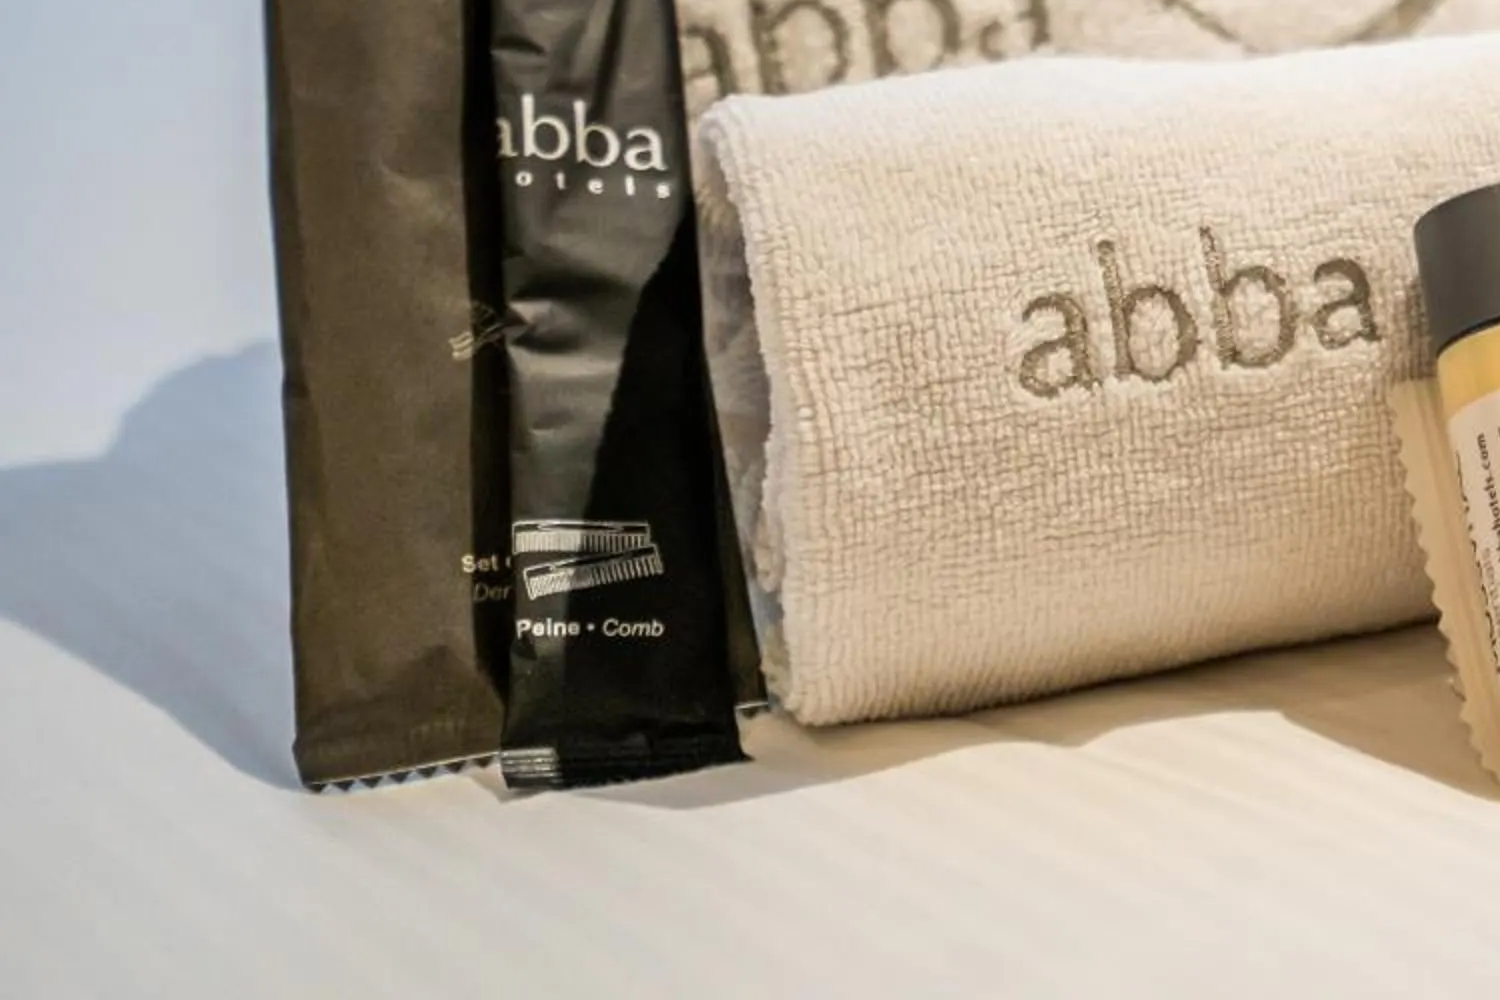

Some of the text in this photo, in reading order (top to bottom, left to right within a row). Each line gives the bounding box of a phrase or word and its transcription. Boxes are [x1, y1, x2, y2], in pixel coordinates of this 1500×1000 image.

[514, 170, 672, 199] otels
[1018, 226, 1382, 398] abba
[516, 618, 666, 640] Peine Comb
